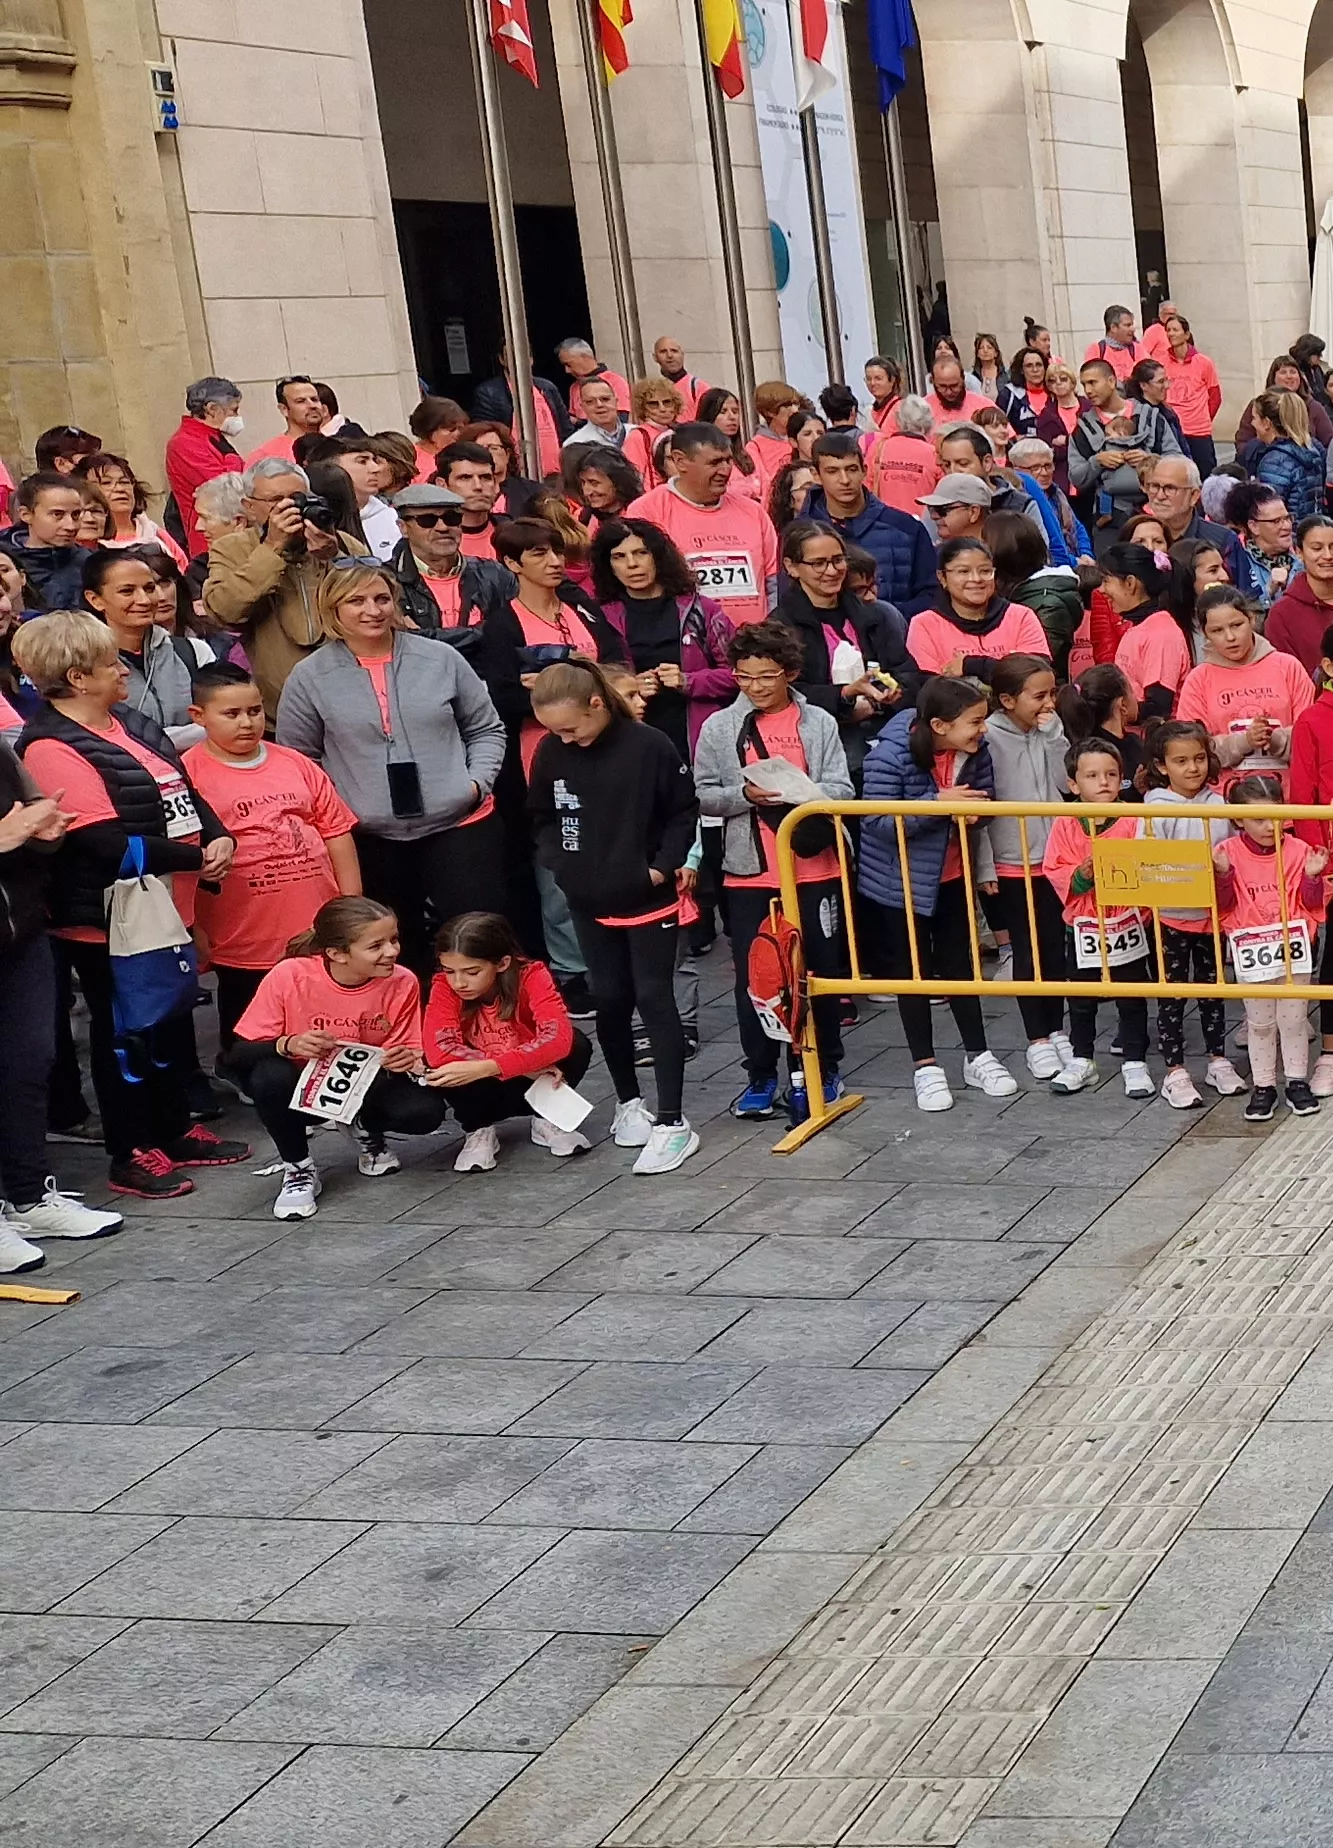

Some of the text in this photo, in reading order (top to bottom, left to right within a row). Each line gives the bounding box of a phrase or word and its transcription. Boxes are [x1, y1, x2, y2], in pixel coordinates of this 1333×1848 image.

[697, 568, 748, 586] 2871
[1235, 686, 1273, 697] CÁNCER
[254, 792, 298, 805] CÁNCER
[1083, 929, 1140, 955] 3645
[1275, 931, 1301, 941] CÁCER
[1241, 941, 1304, 969] 3648
[318, 1047, 371, 1110] 1646
